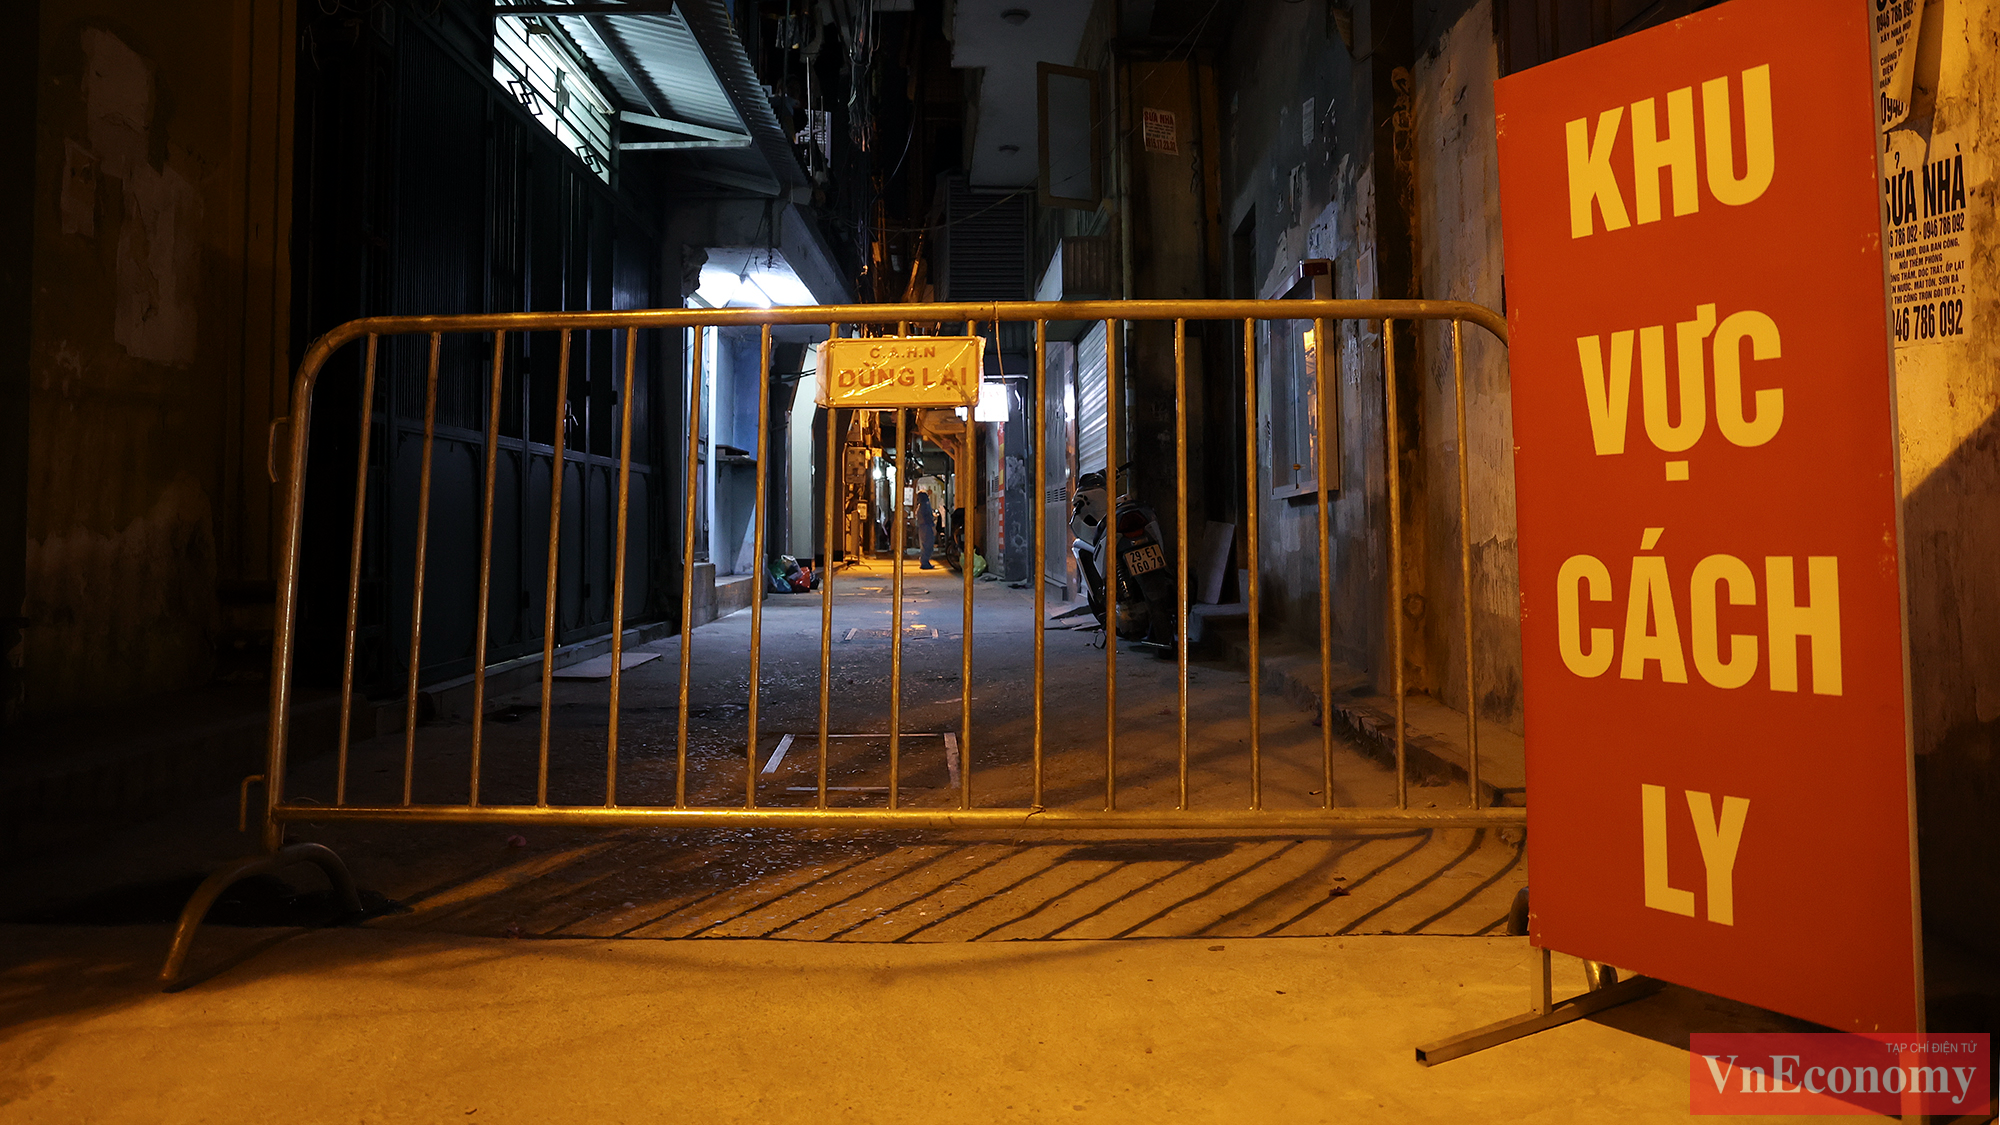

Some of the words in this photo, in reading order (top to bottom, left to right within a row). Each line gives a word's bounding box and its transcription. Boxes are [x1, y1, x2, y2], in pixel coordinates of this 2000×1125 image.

[1565, 63, 1776, 240] KHU
[1922, 142, 1966, 219] NHÀ
[1922, 218, 1938, 240] 0946
[1938, 216, 1951, 236] 786
[1952, 212, 1965, 234] 092
[1892, 306, 1910, 342] 46
[1913, 302, 1936, 340] 786
[1940, 298, 1964, 338] 092
[1961, 284, 1966, 294] Z
[1576, 302, 1784, 482] VỰC
[1556, 527, 1843, 696] CÁCH
[1641, 783, 1751, 927] LY
